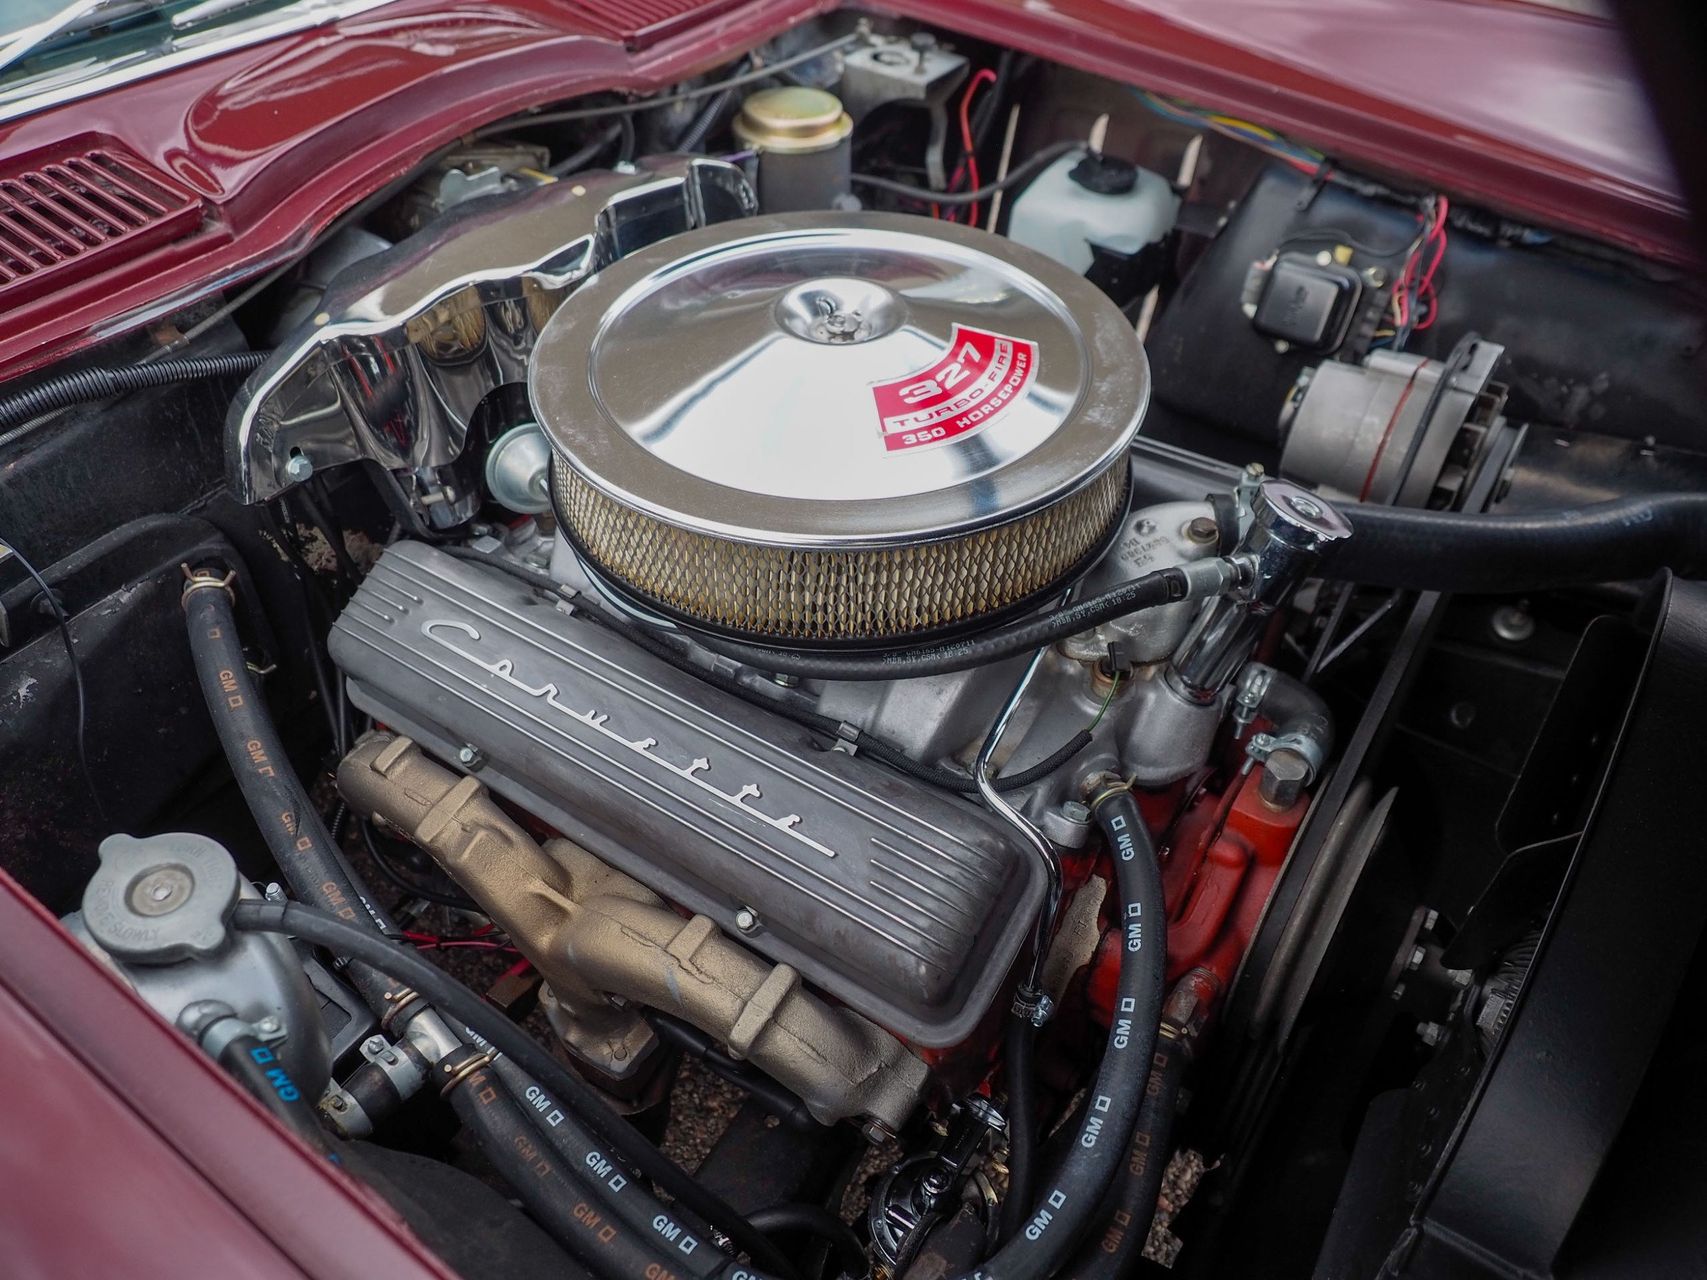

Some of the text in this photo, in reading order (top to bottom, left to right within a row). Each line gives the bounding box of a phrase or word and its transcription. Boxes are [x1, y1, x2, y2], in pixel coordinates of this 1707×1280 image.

[892, 341, 1009, 427] TURBO-FIRE
[898, 341, 981, 405] 327
[901, 351, 1028, 445] 350 HORSEPOWER
[219, 669, 238, 693] GM
[247, 740, 268, 764] GM
[420, 619, 838, 858] Corvette
[1117, 833, 1135, 861] GM
[322, 882, 347, 906] GM
[108, 922, 161, 942] SLOWLY
[1127, 923, 1142, 952] GM
[1114, 1019, 1132, 1049] GM
[264, 1067, 301, 1103] GM
[467, 1069, 487, 1087] M
[1147, 1069, 1163, 1097] GM
[525, 1086, 551, 1113] GM
[1081, 1116, 1104, 1148] GM
[514, 1135, 537, 1162] GM
[1129, 1148, 1148, 1177] GM
[585, 1151, 613, 1178] GM
[572, 1202, 602, 1229] GM
[652, 1214, 682, 1242] GM
[1025, 1209, 1053, 1241] GM
[1101, 1225, 1125, 1253] GM
